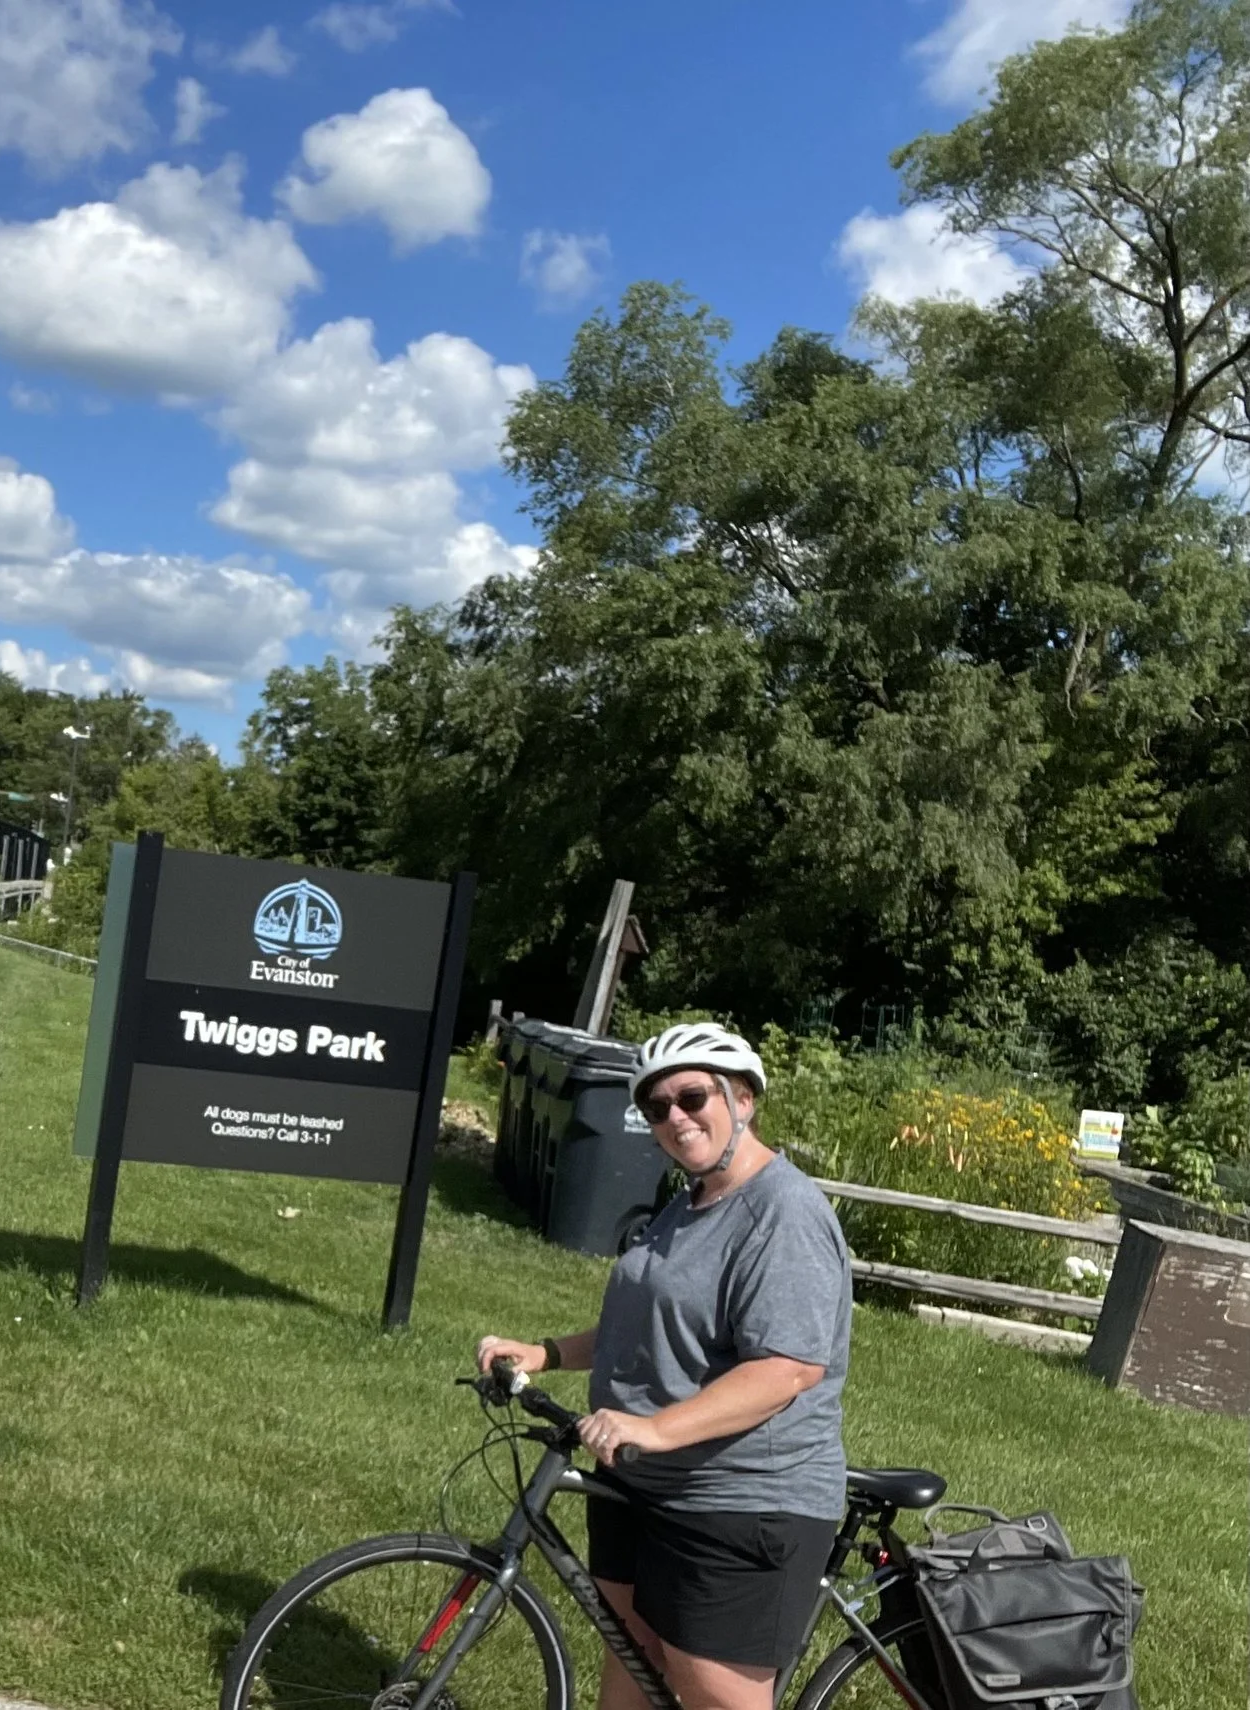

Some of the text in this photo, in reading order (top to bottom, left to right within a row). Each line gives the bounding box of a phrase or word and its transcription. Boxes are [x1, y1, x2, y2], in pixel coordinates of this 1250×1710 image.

[250, 960, 334, 989] Evanston
[277, 955, 311, 969] City of
[179, 1010, 386, 1062] Twiggs Park
[204, 1105, 344, 1131] All dogs must be leashed
[211, 1122, 331, 1145] Questions? Call 3-1-1
